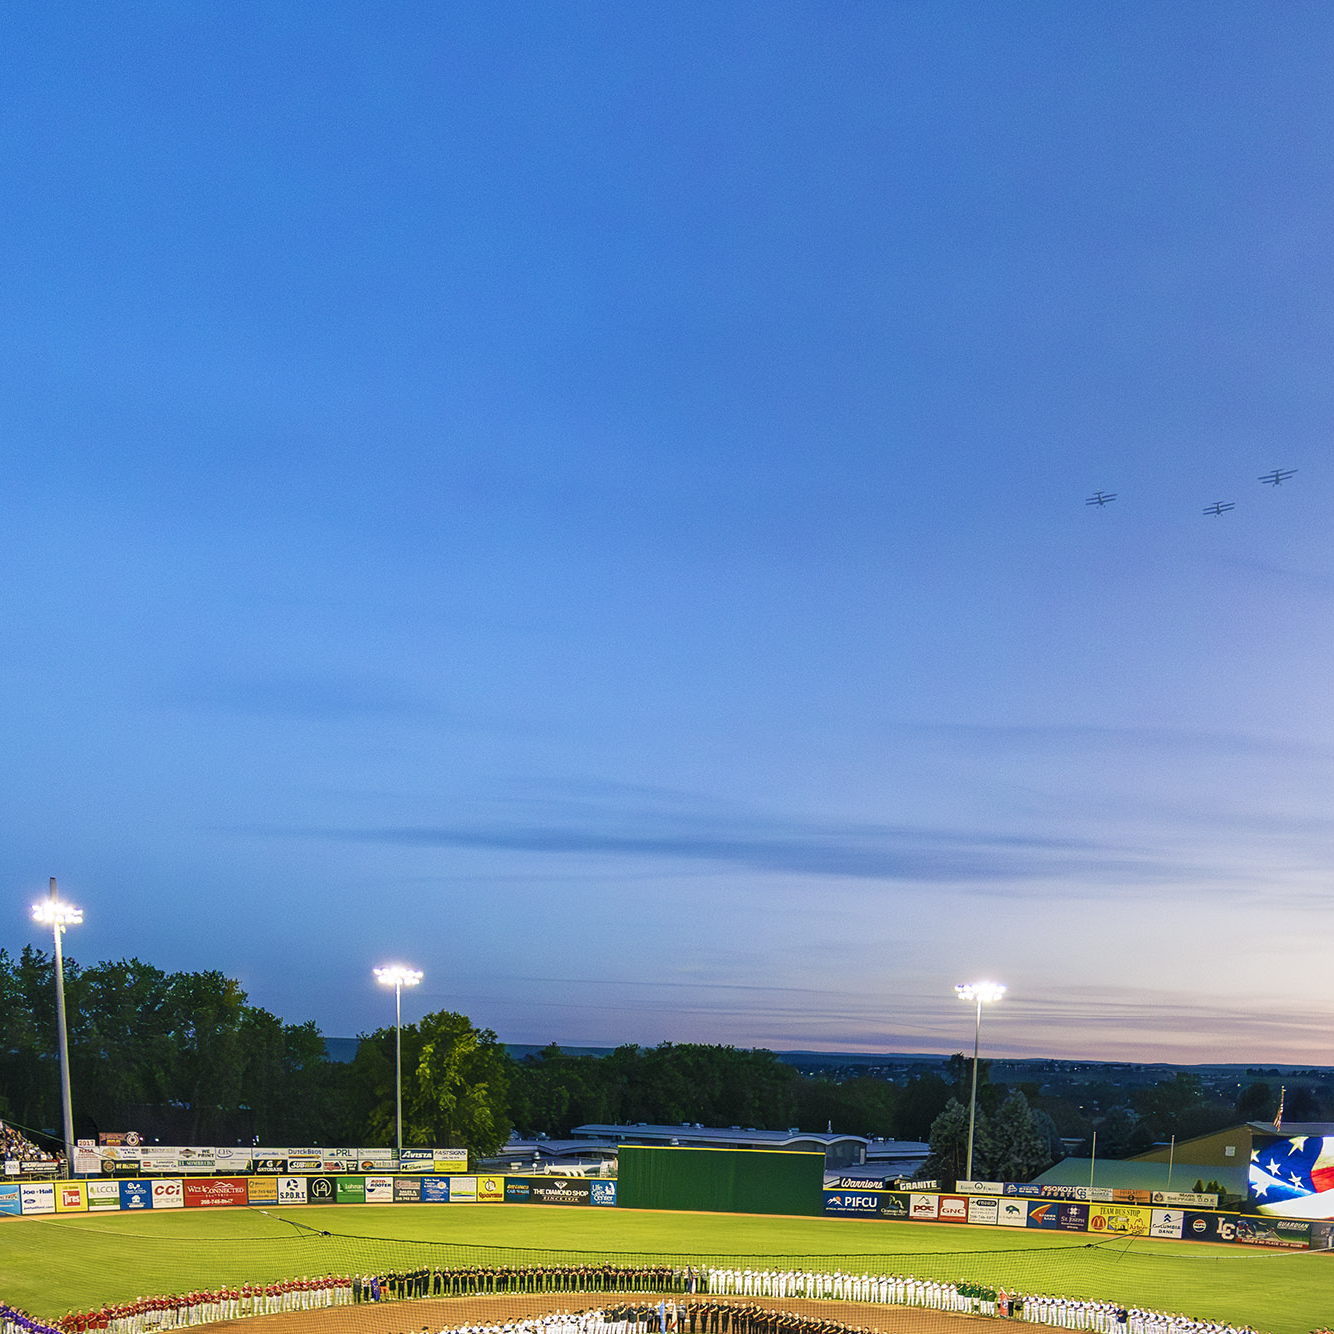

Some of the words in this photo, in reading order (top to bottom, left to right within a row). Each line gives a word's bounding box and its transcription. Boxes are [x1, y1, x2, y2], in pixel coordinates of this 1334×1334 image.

[336, 1149, 352, 1157] PRL
[841, 1178, 883, 1189] Warriors
[900, 1180, 937, 1190] GRANITE
[845, 1197, 877, 1207] P1FCU
[1277, 1221, 1309, 1229] GUARDIAN
